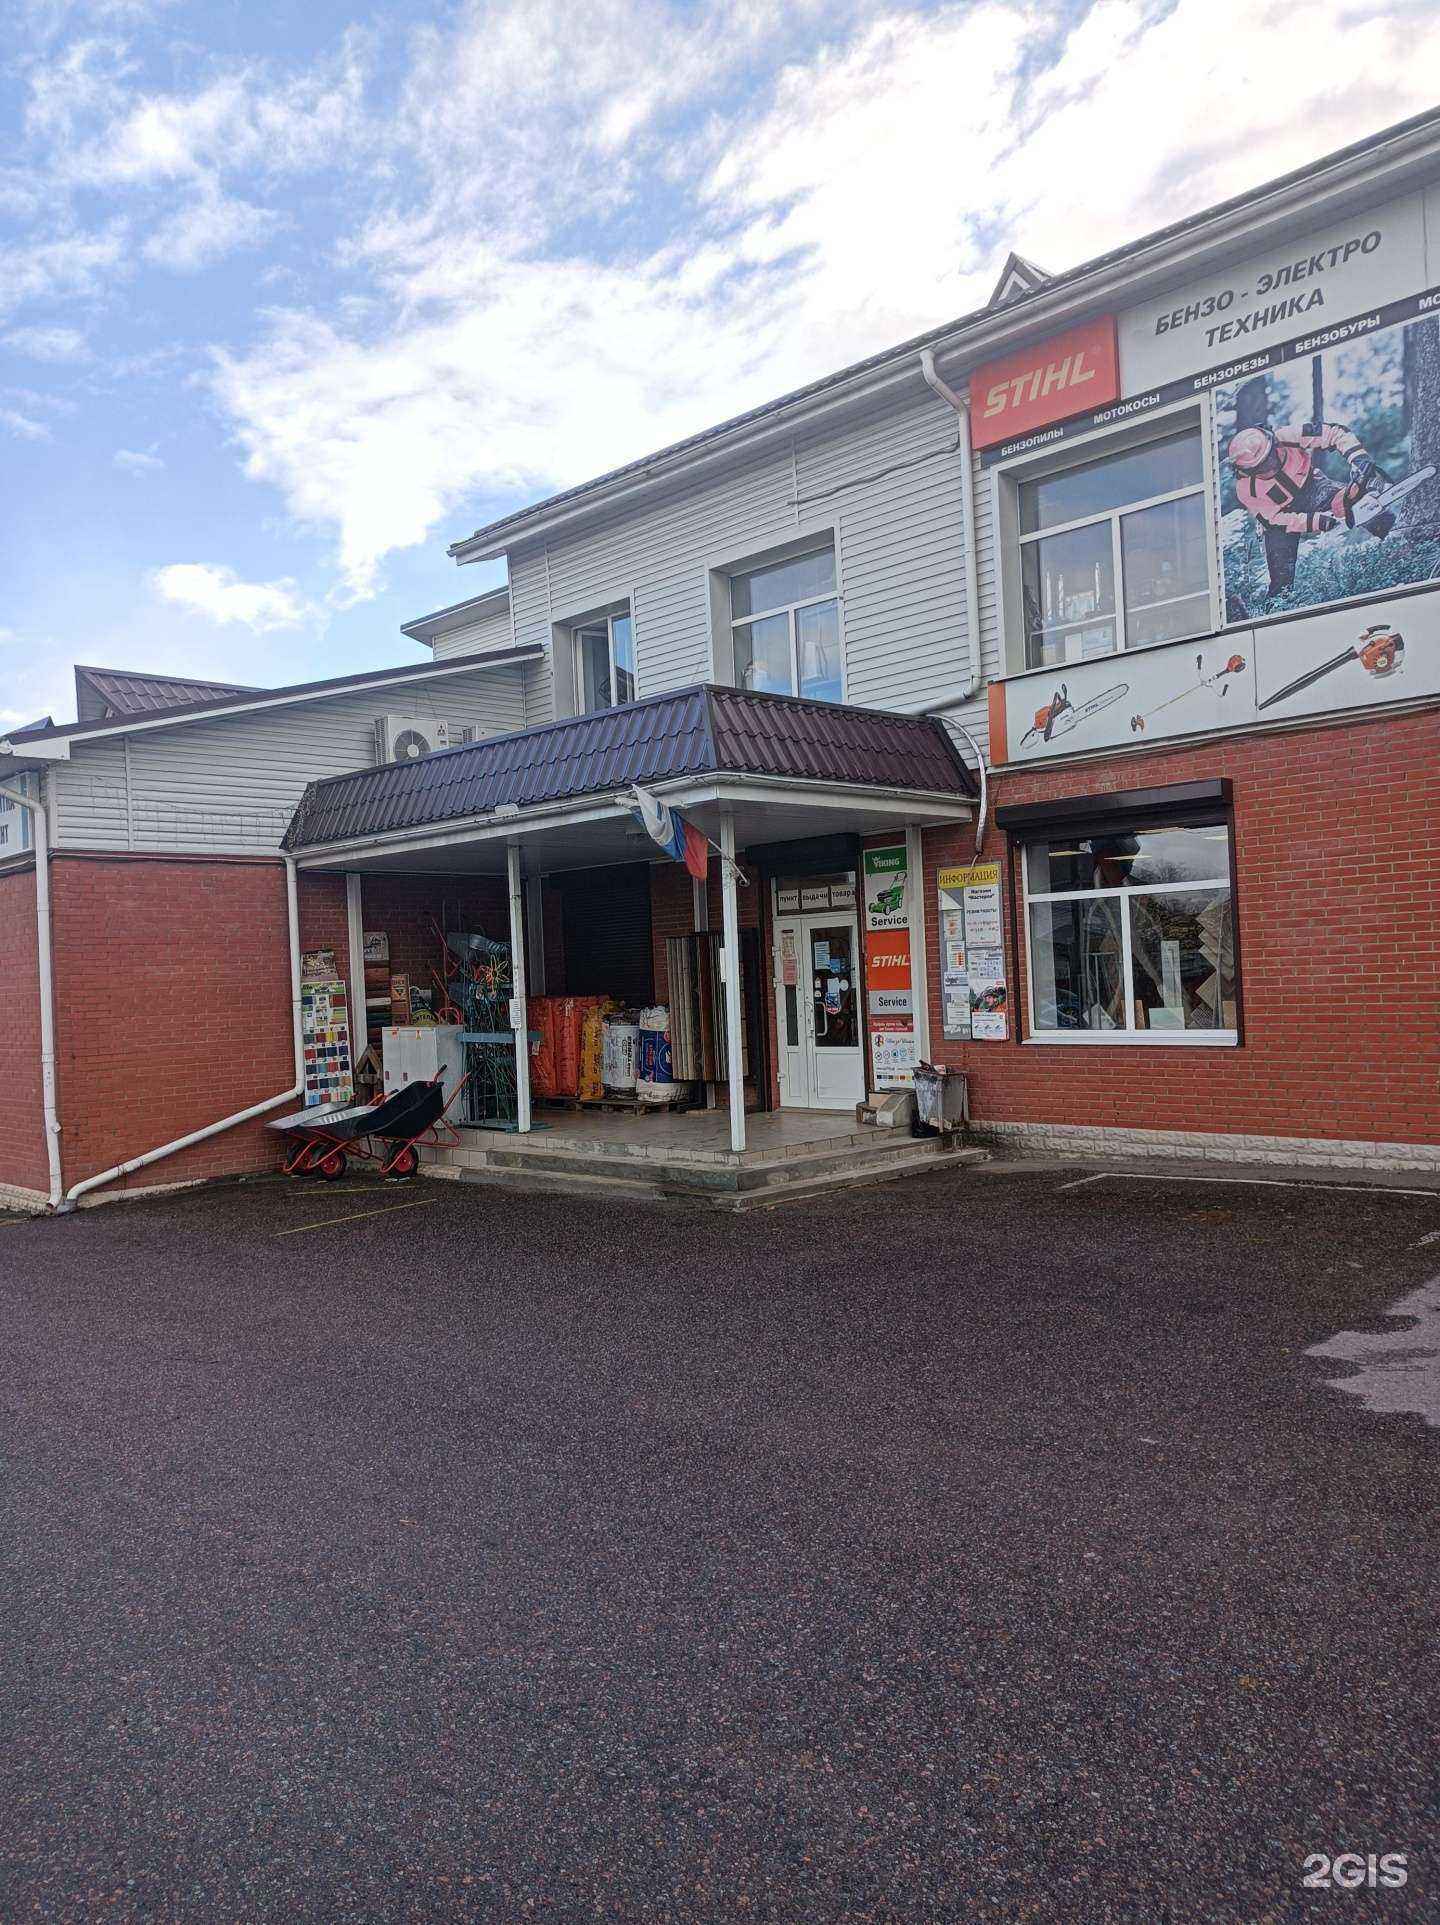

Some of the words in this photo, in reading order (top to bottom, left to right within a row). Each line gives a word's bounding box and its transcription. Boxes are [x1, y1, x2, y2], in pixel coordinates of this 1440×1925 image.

[1155, 289, 1234, 336] БЕНЗО
[1256, 230, 1382, 296] ЭЛЕКТРО
[1205, 288, 1325, 348] ТЕХНИКА
[984, 352, 1095, 418] STIHL
[1001, 427, 1064, 457] БЕНЗОПИЛЫ
[1093, 394, 1160, 425] МОТОКОСЫ
[1193, 354, 1270, 389] БЕНЗОРЕЗЫ
[1295, 314, 1381, 354] БЕНЗОБУРЫ
[872, 856, 901, 868] VIKING
[871, 914, 908, 927] Service
[872, 954, 911, 968] STIHL
[879, 996, 907, 1007] Service
